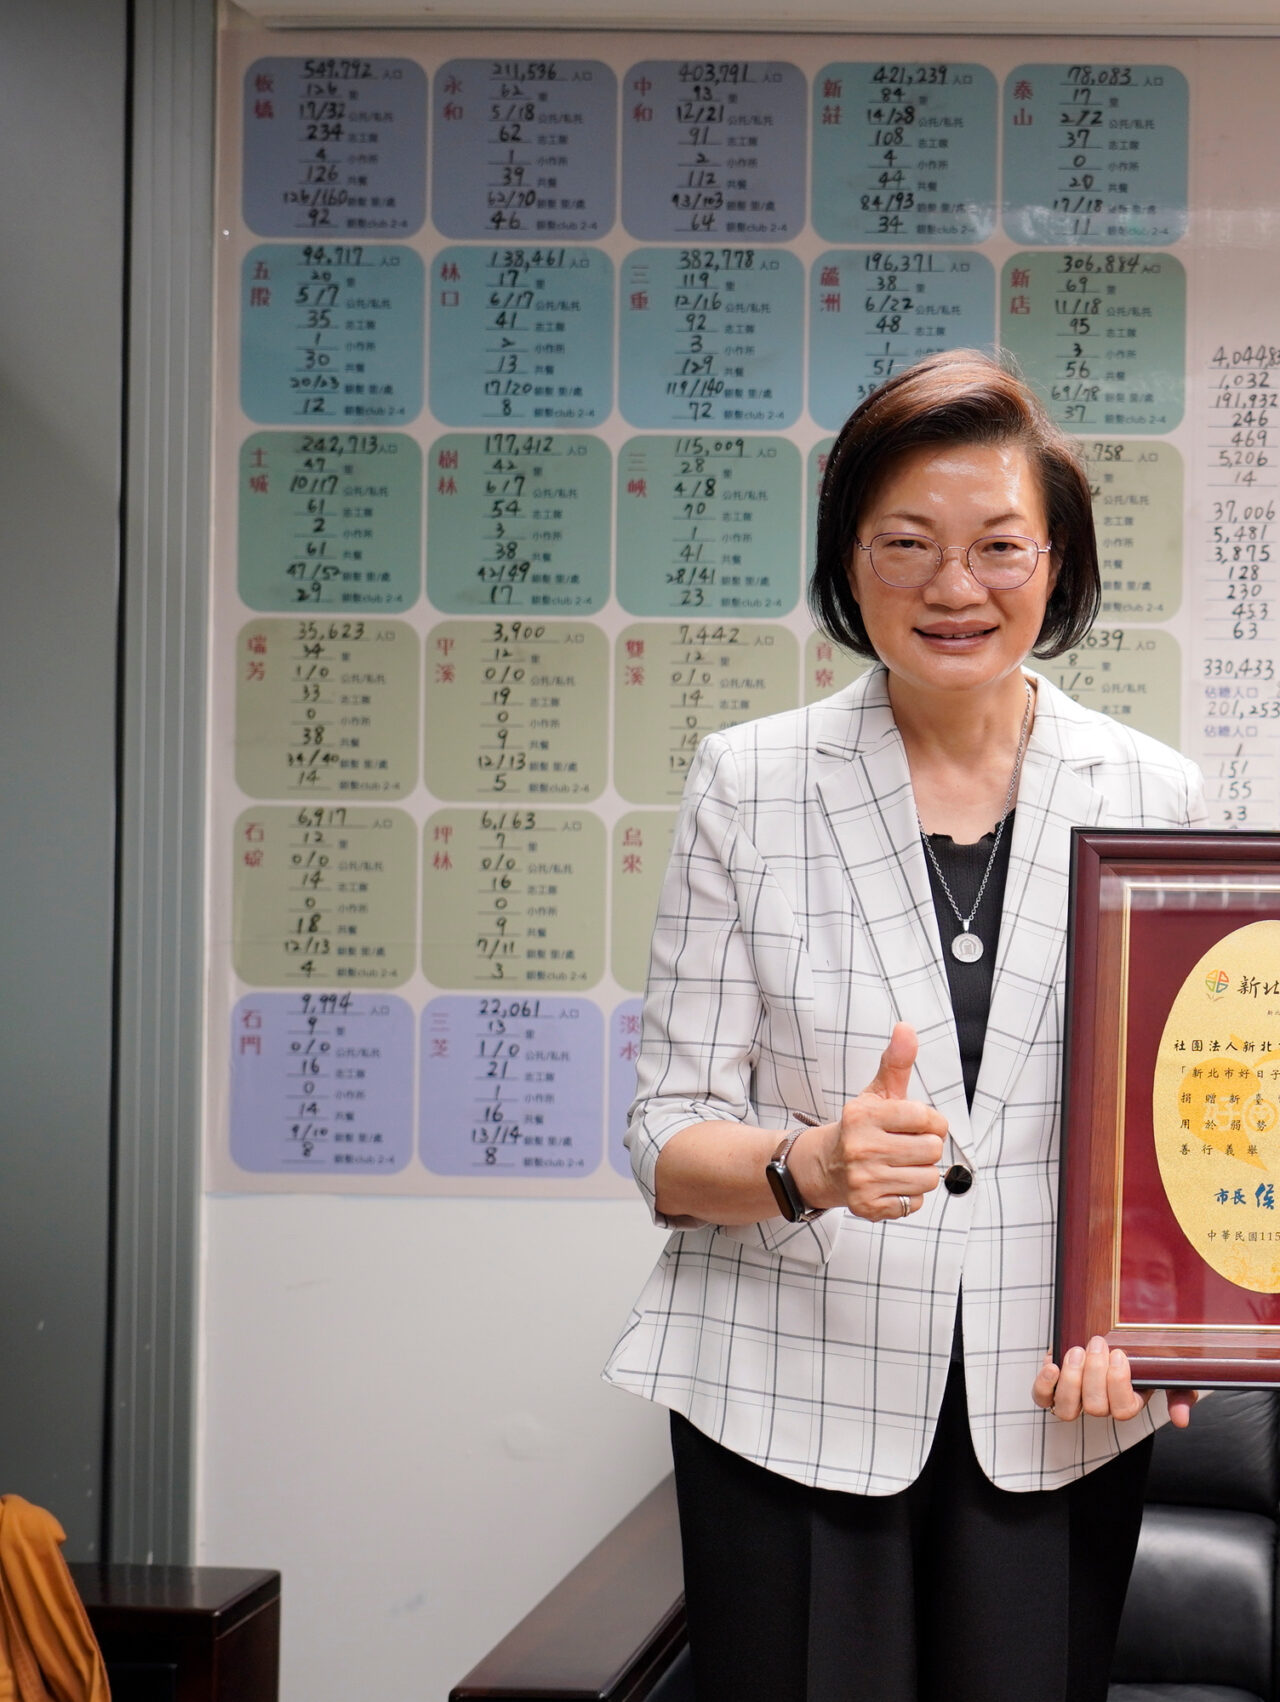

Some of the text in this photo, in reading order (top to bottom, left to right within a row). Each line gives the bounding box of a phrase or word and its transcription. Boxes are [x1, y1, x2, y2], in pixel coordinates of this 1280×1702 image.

[443, 77, 463, 120] 永和
[633, 79, 653, 123] 中和
[822, 79, 843, 125] 新莊
[1013, 81, 1033, 126] 泰山
[440, 263, 460, 307] 林口
[630, 265, 649, 312] 三重
[820, 266, 840, 313] 蘆洲
[1010, 268, 1030, 315] 新店
[1231, 429, 1267, 448] 469
[1232, 410, 1268, 428] 246
[250, 447, 269, 493] 土城
[1235, 471, 1256, 487] 14
[1226, 584, 1262, 600] 230
[1229, 565, 1259, 580] 128
[1233, 622, 1257, 640] 63
[240, 1009, 262, 1055] 石門
[430, 1012, 449, 1058] 三芝
[1179, 1144, 1258, 1157] 善行義舉
[1214, 1188, 1247, 1205] 市長
